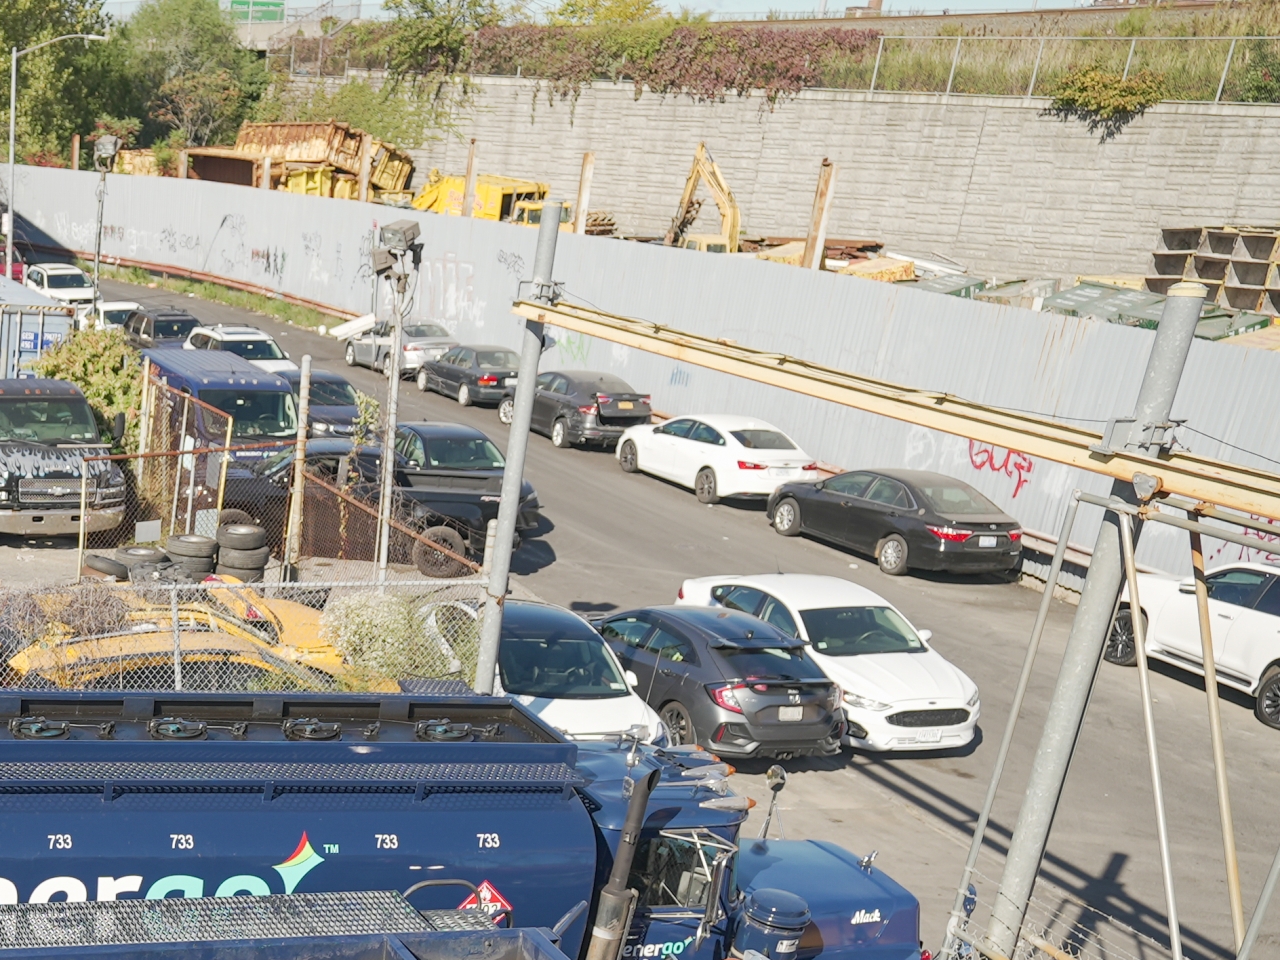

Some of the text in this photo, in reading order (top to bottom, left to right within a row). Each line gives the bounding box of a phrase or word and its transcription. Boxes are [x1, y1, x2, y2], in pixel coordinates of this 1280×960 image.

[48, 834, 72, 849] 733
[170, 834, 194, 849] 733
[375, 834, 399, 849] 733
[476, 833, 500, 848] 733
[324, 844, 339, 853] TM
[850, 909, 881, 925] Mack
[622, 941, 685, 959] energo
